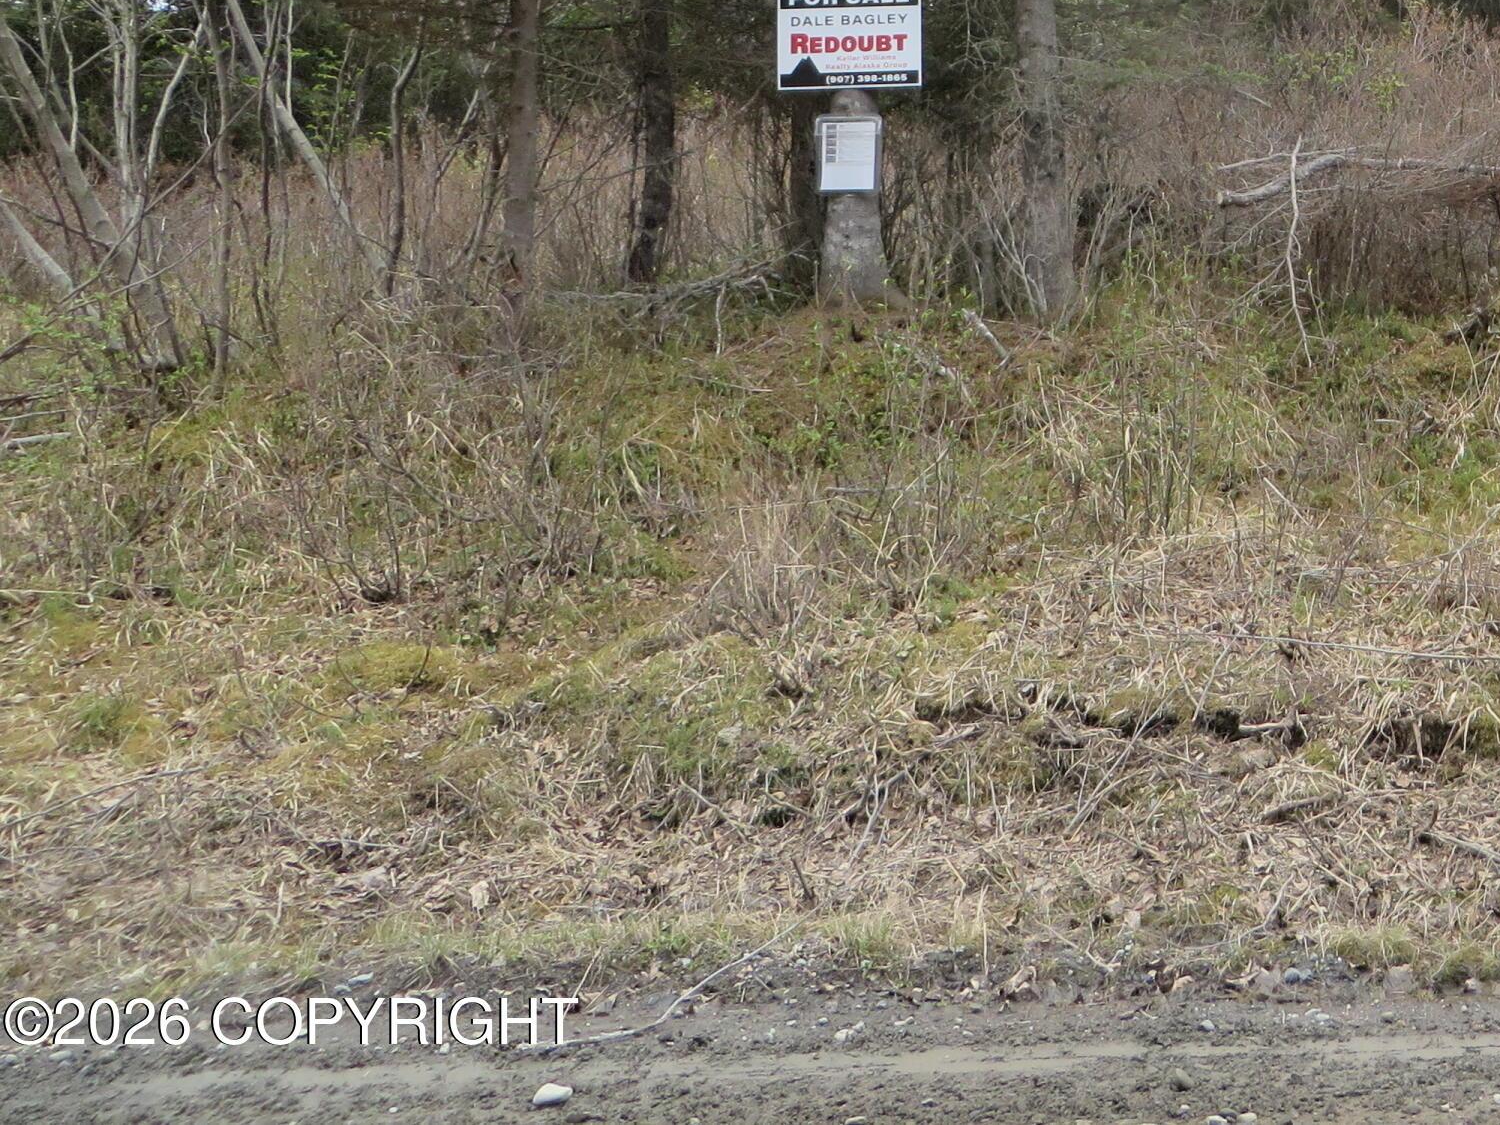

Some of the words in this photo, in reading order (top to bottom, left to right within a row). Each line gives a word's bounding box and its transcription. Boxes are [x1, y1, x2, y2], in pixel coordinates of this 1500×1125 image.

[791, 16, 834, 27] DALE
[841, 14, 908, 25] BAGLEY
[790, 33, 908, 54] REDOUBT
[883, 61, 908, 69] Group
[825, 75, 854, 85] (907)
